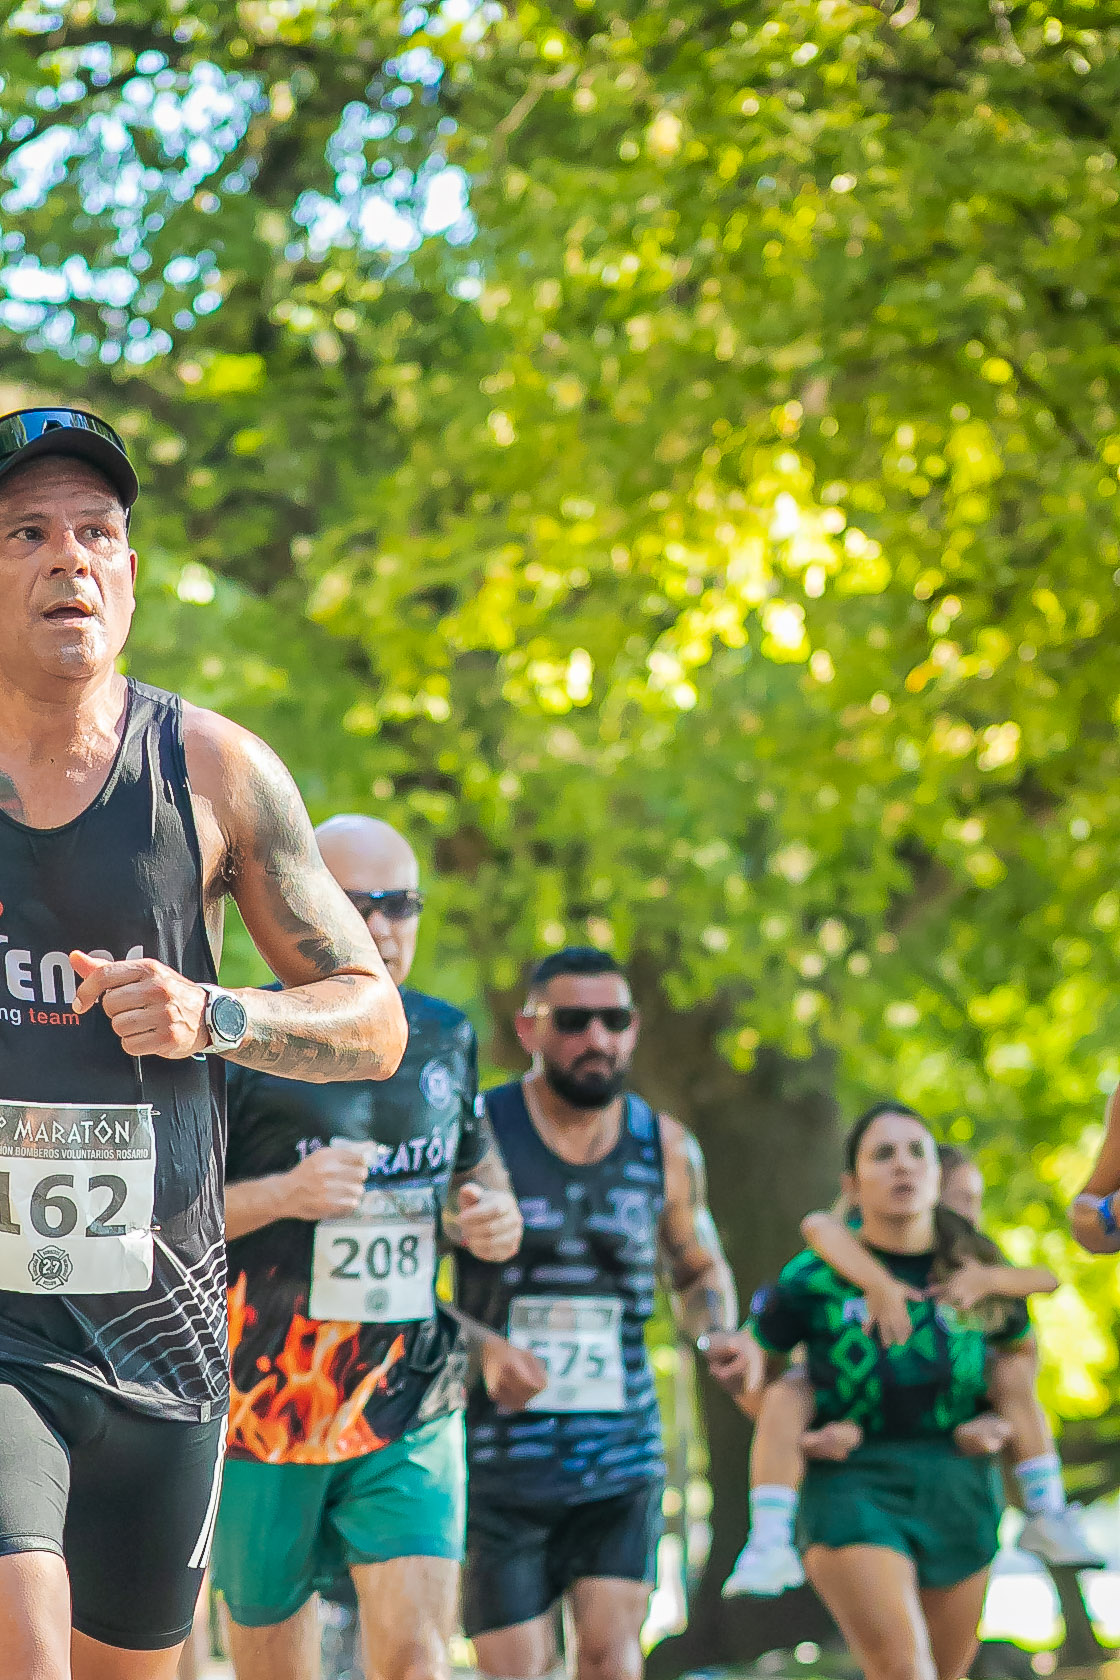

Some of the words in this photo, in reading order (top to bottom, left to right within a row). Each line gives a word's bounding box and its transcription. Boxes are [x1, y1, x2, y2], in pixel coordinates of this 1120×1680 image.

[29, 1007, 80, 1026] team
[13, 1114, 131, 1144] MARATÓN
[15, 1147, 60, 1159] BOMBEROS
[62, 1148, 114, 1160] VOLUNTARIOS
[116, 1147, 149, 1160] ROSARIO
[42, 1258, 60, 1275] 27
[329, 1235, 419, 1279] 208
